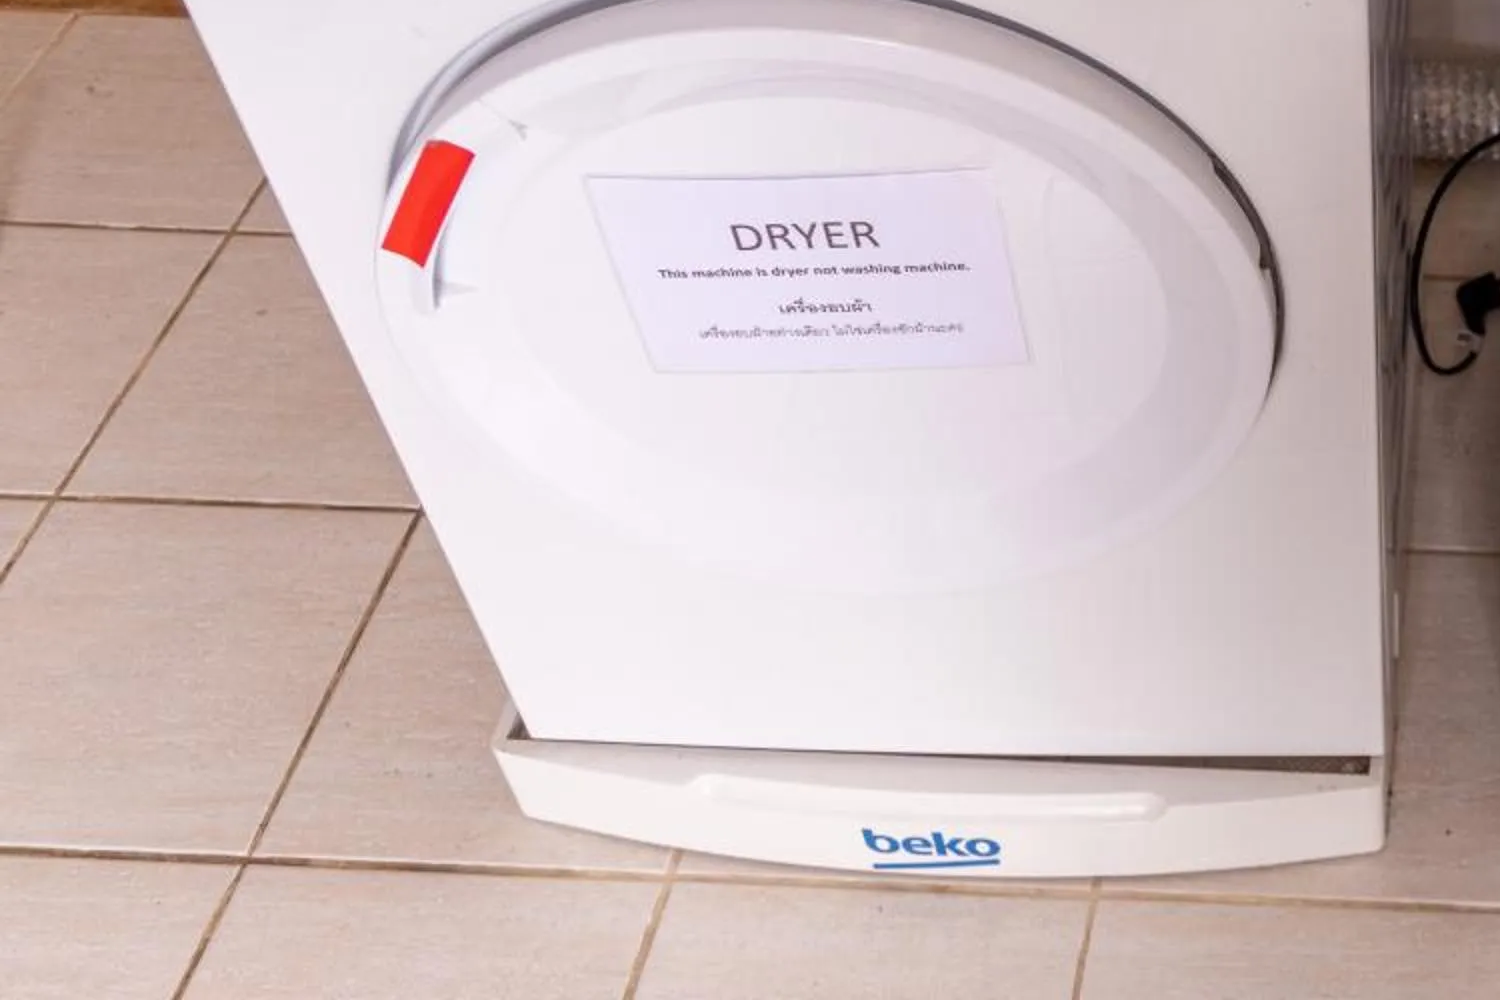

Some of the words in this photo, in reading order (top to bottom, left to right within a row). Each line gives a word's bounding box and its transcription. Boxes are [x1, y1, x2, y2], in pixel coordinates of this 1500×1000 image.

[730, 220, 881, 252] DRYER
[658, 269, 688, 279] This
[692, 268, 751, 278] machine
[757, 267, 769, 277] is
[771, 266, 809, 279] dryer
[813, 265, 838, 276] not
[841, 264, 901, 277] washing
[904, 262, 971, 274] machine.
[778, 296, 873, 315] เครื่องอบผ้า
[861, 827, 1001, 857] beko
